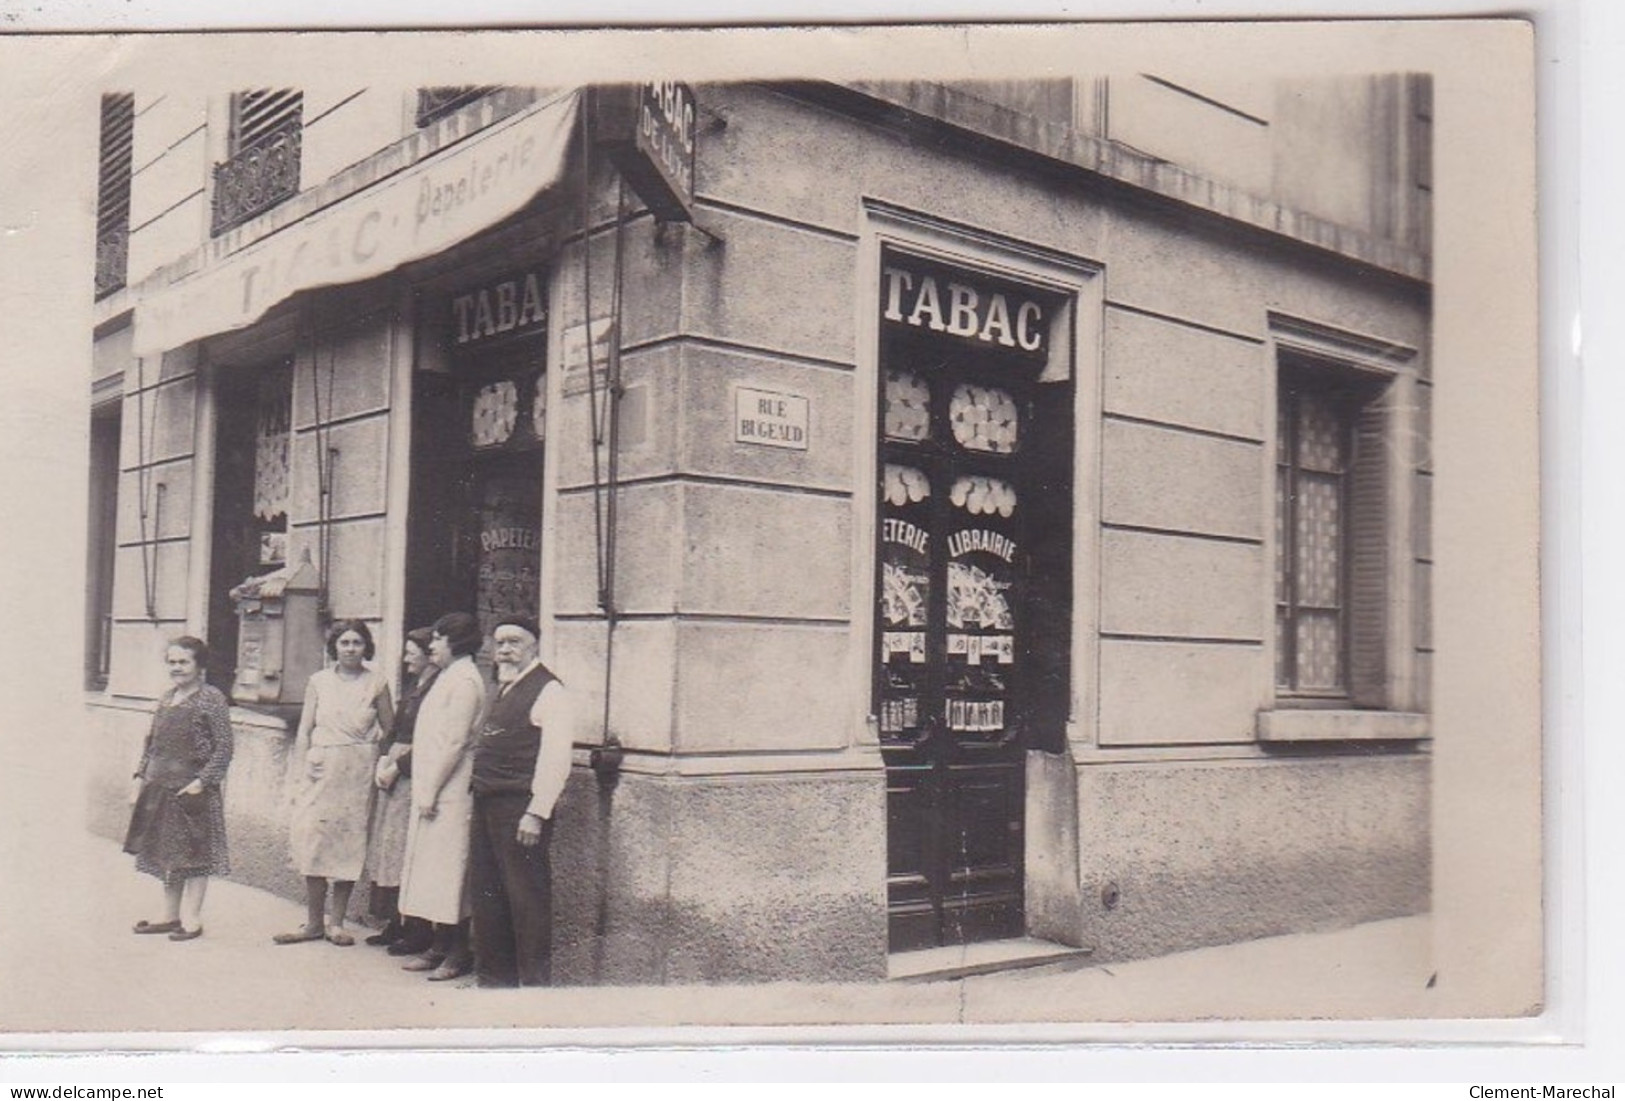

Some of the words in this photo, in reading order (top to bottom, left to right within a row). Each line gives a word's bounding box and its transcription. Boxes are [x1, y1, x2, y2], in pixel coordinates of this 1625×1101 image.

[643, 105, 660, 150] DE
[646, 81, 693, 154] ABAC
[454, 274, 546, 343] TABA
[884, 267, 1042, 351] TABAC
[758, 399, 787, 418] RUE
[741, 420, 804, 442] BUGEAUD
[883, 518, 929, 555] ETERIE
[947, 529, 1017, 563] LIBRAIRIE
